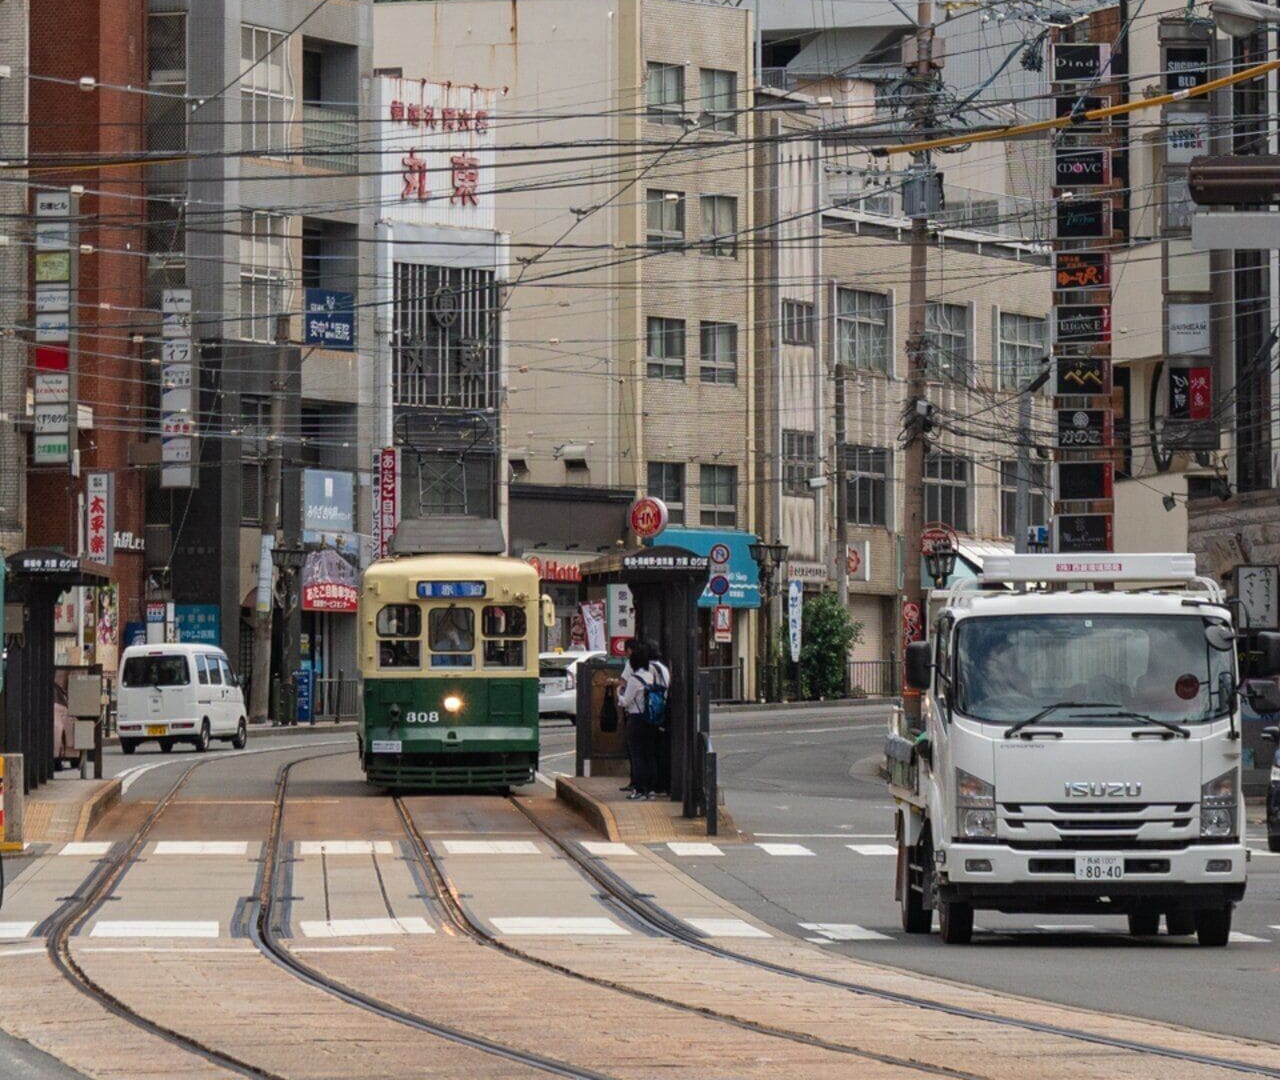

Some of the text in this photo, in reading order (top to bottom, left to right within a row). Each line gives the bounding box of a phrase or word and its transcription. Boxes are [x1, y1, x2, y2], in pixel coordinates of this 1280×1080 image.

[1178, 75, 1197, 88] BLD
[636, 511, 657, 523] HM
[618, 591, 628, 628] 思案橋
[406, 711, 440, 723] 808
[1064, 781, 1142, 798] ISUZU
[1086, 866, 1121, 879] 80-40
